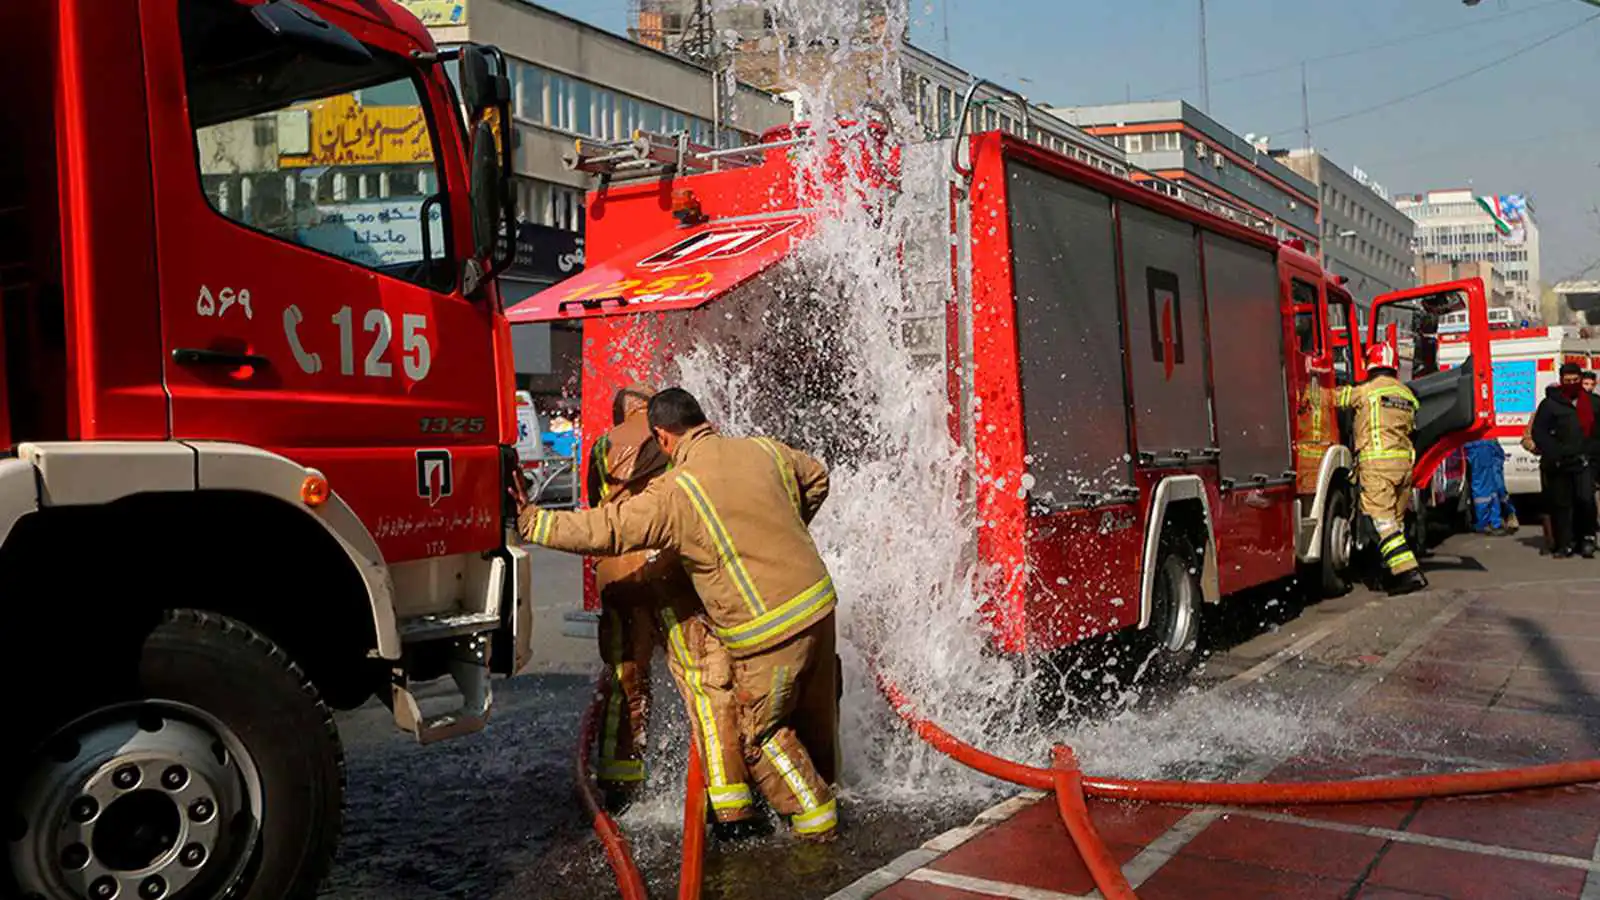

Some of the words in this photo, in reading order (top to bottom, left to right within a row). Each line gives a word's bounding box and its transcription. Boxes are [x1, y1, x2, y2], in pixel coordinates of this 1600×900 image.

[196, 284, 253, 321] ۵۶۹
[331, 304, 432, 382] 125
[420, 416, 485, 433] 1325
